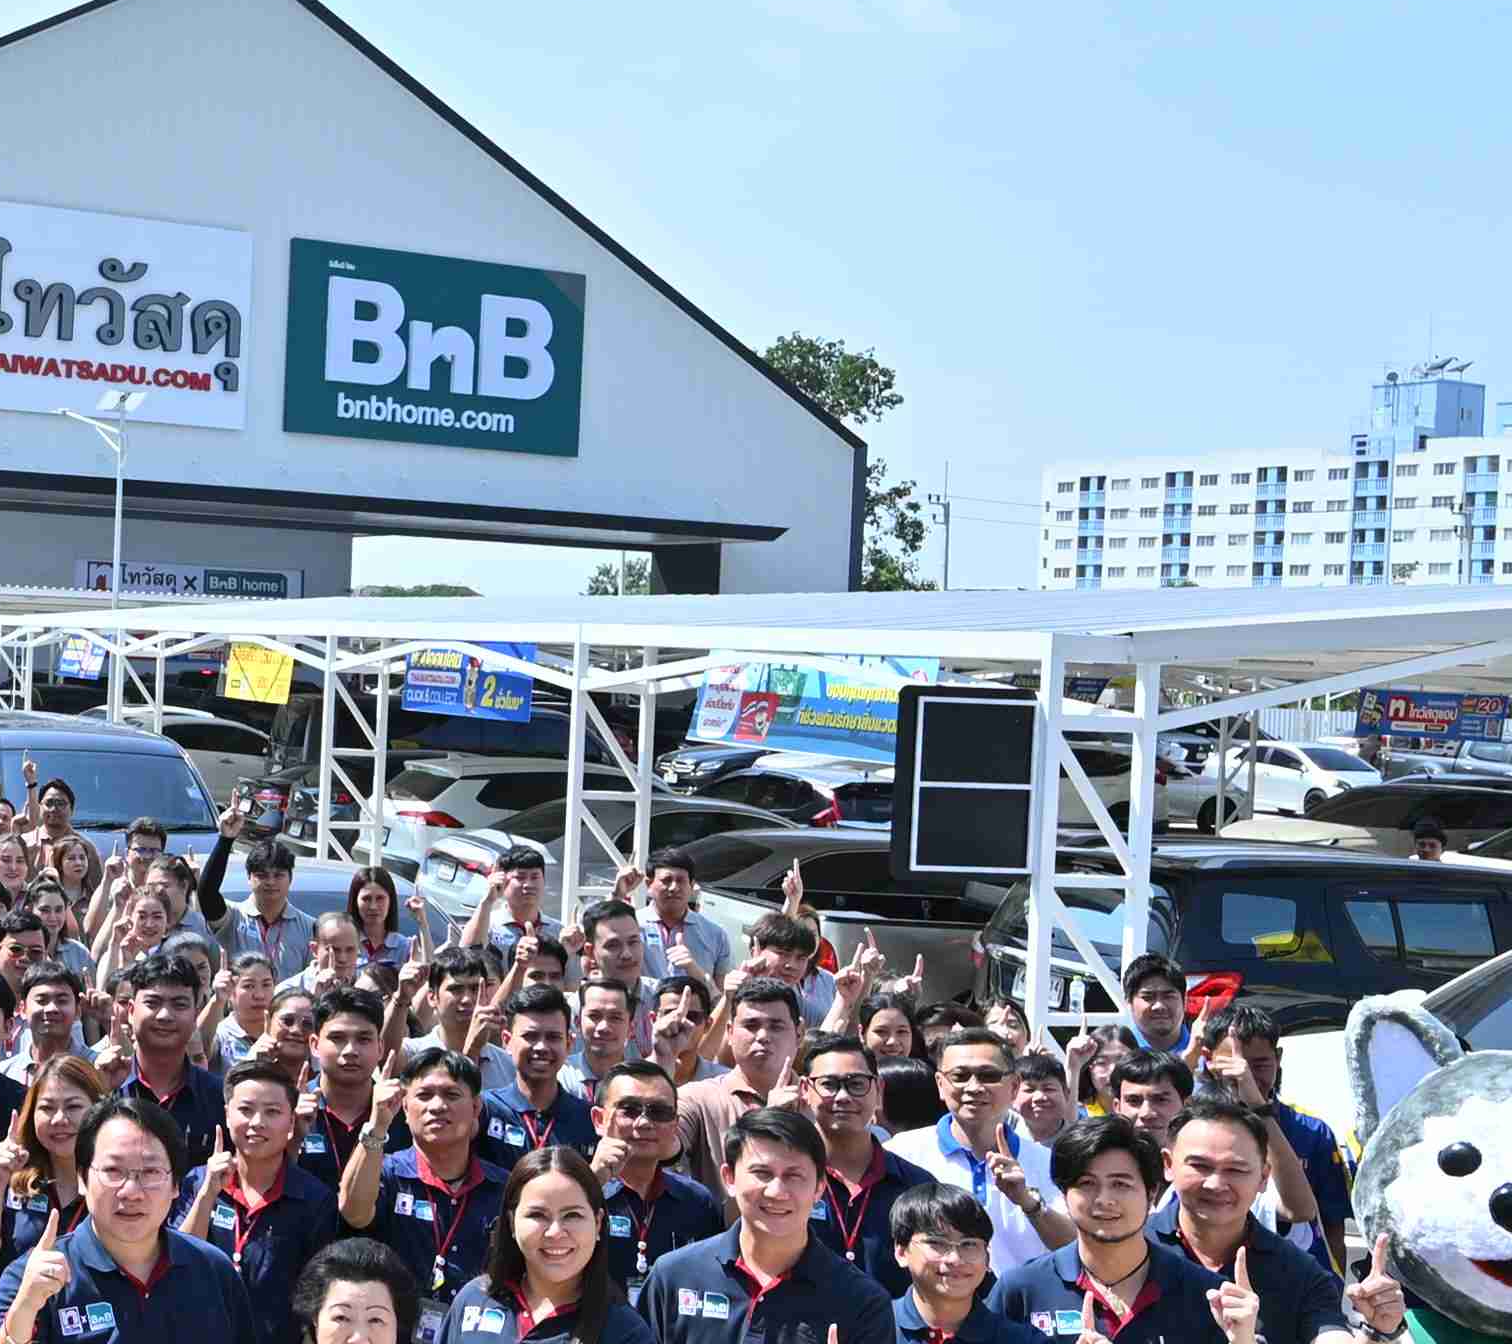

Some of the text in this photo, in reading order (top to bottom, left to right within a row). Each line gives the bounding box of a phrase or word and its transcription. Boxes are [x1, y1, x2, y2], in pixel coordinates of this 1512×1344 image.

[324, 275, 555, 402] BnB
[336, 392, 515, 434] bnbhome.com
[208, 575, 280, 593] BnB home
[480, 675, 497, 707] 2
